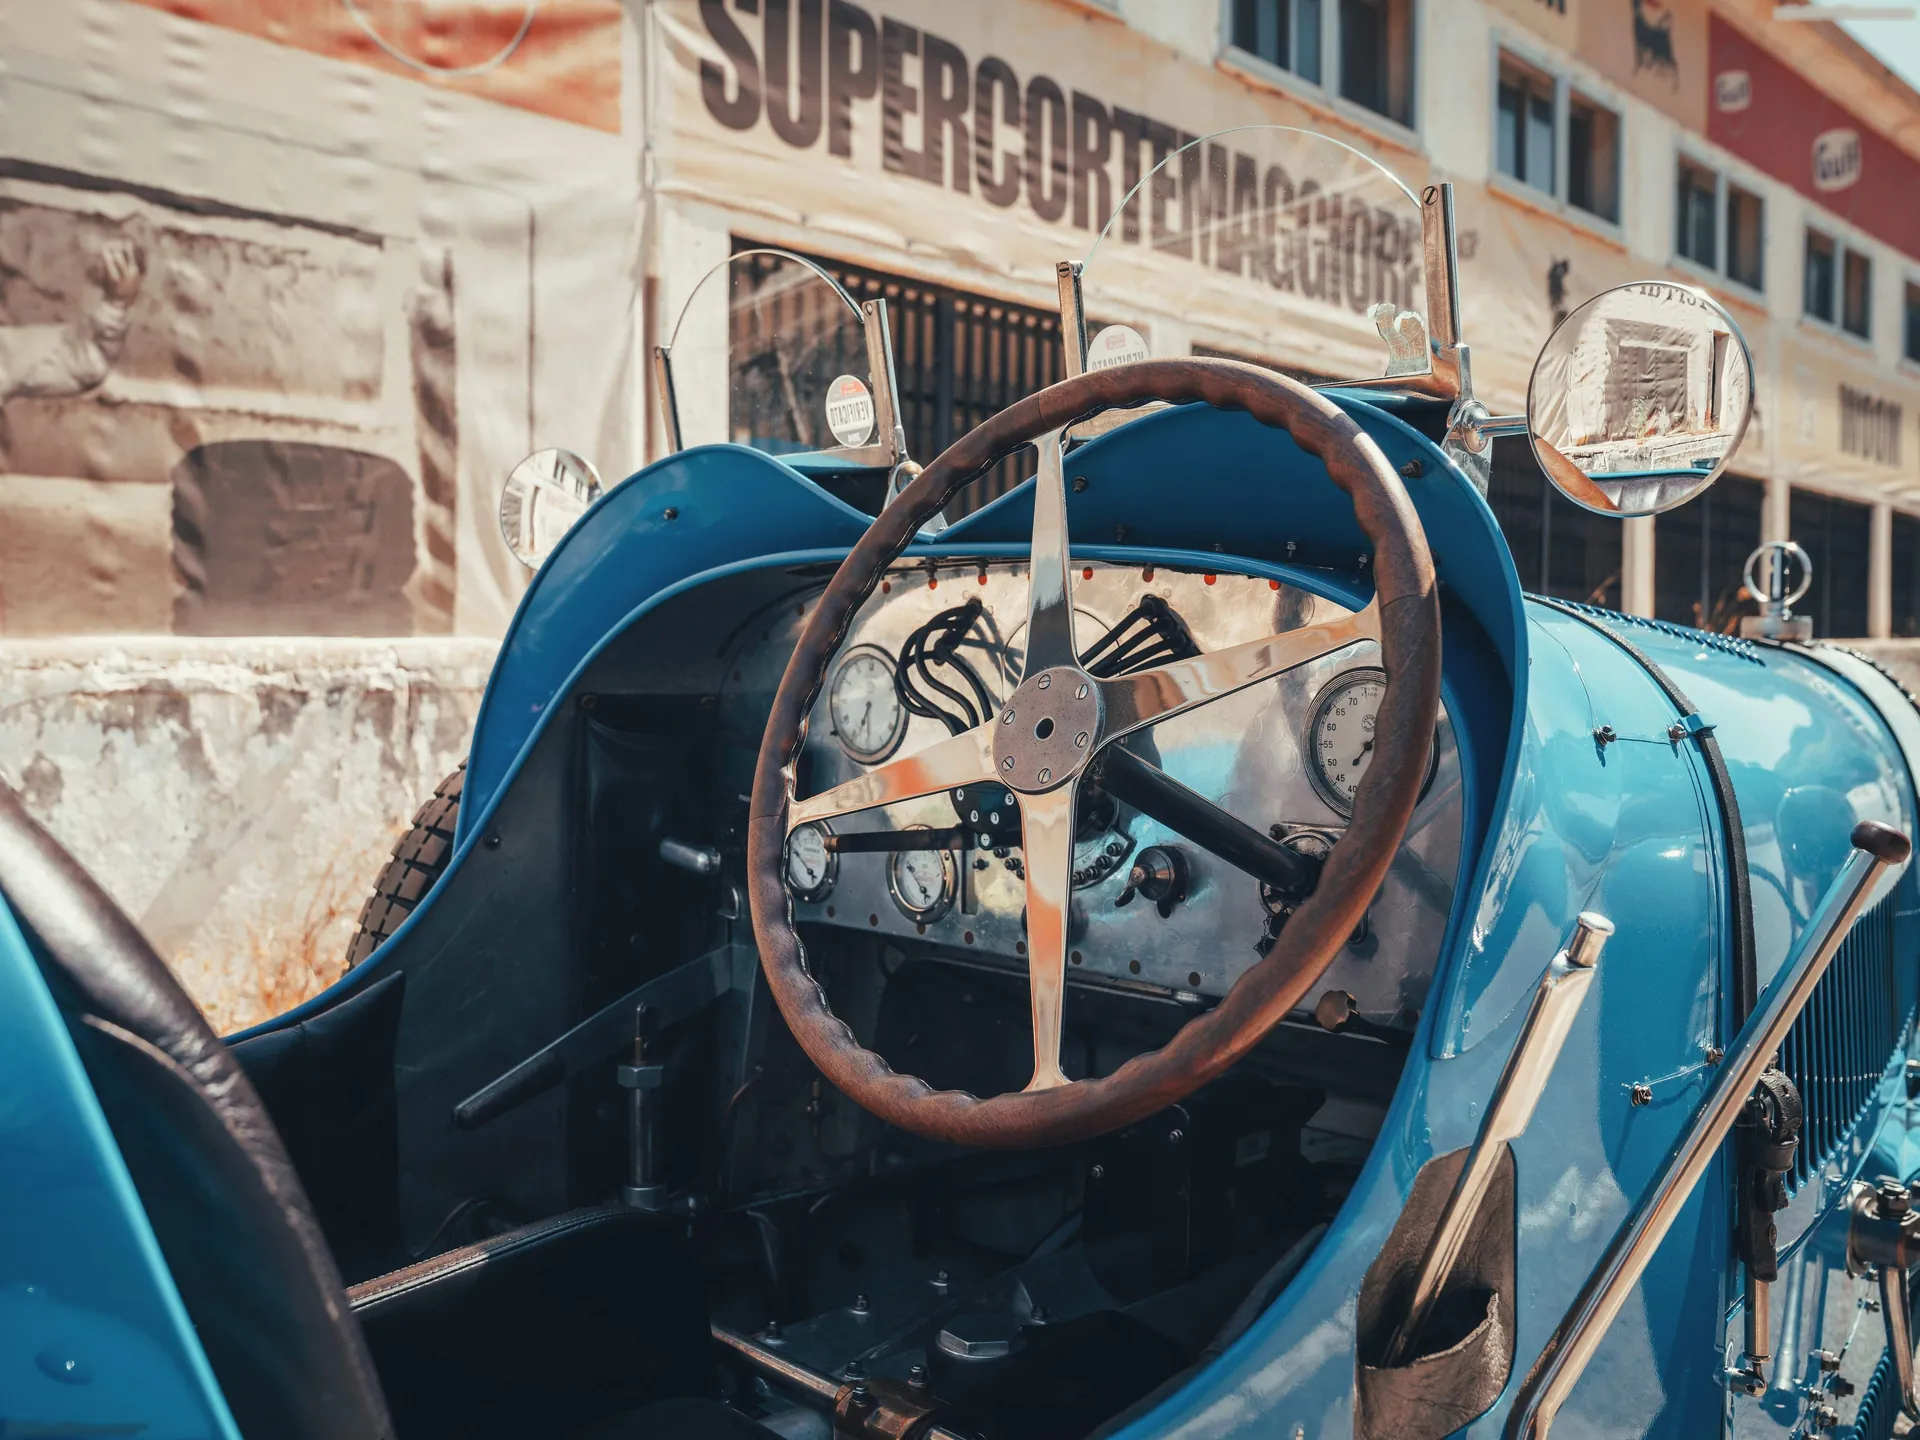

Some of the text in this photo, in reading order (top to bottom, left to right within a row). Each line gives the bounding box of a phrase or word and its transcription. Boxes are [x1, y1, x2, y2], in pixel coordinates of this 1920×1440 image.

[1815, 137, 1860, 181] Gulf
[1348, 697, 1358, 706] 70
[1335, 708, 1346, 717] 65
[1326, 723, 1337, 731] 60
[1323, 740, 1334, 749] 55
[1327, 758, 1337, 767] 50
[1335, 774, 1346, 782] 45
[1347, 785, 1357, 793] 40
